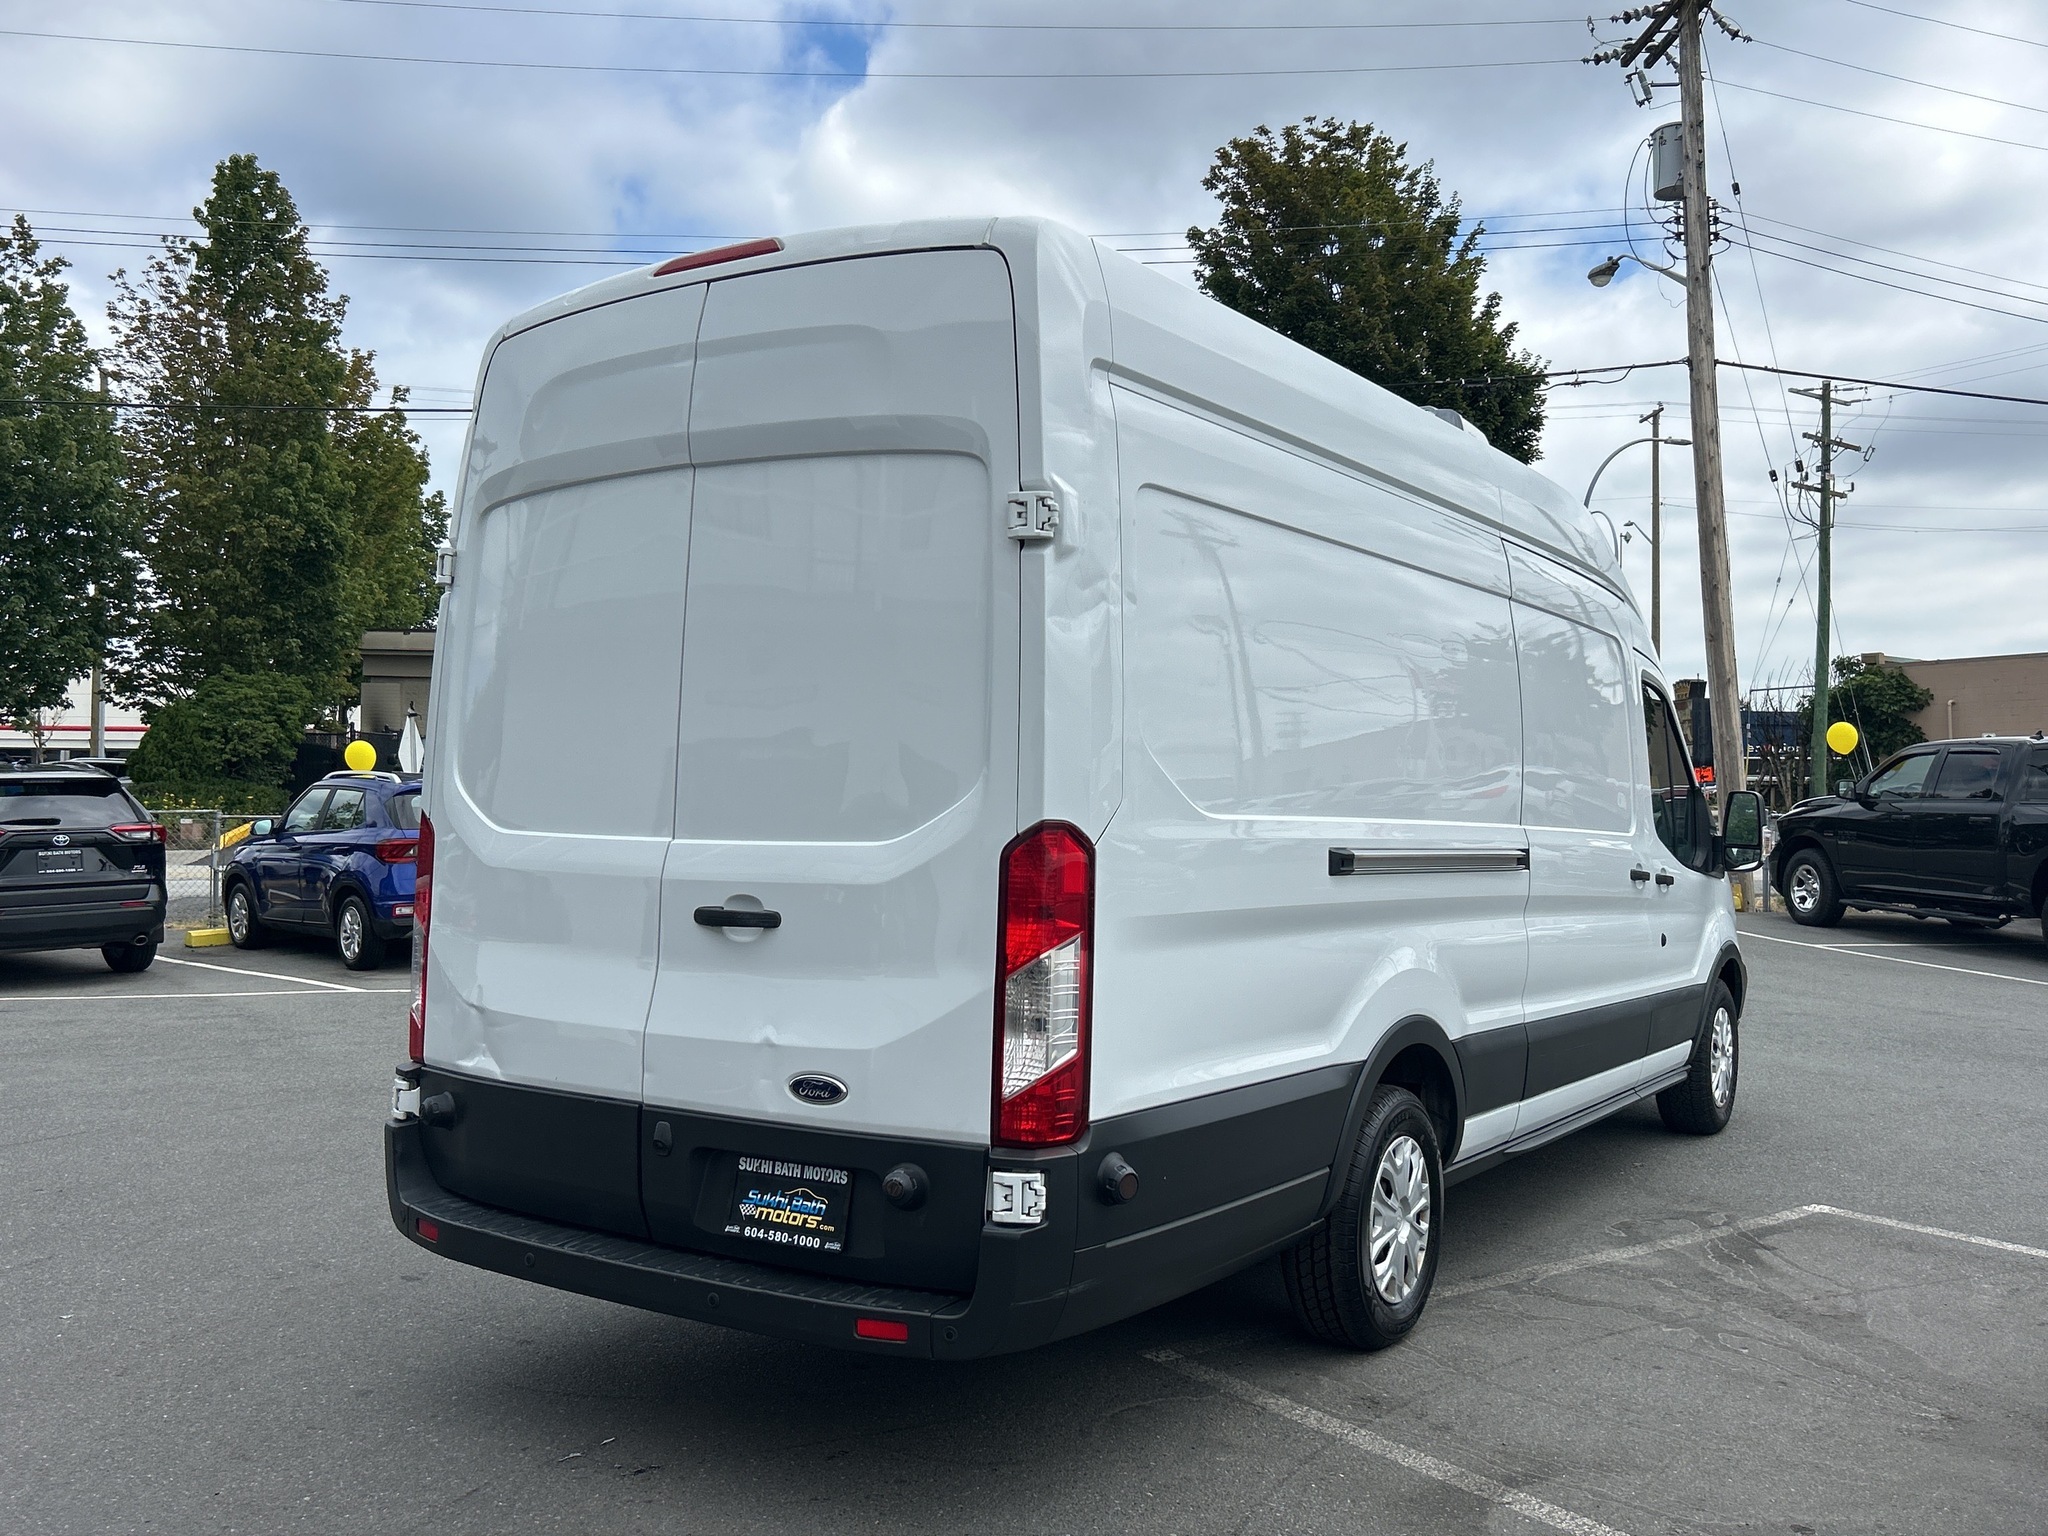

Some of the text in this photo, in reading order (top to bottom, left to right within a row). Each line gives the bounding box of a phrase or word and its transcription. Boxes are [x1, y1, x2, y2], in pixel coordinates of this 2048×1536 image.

[799, 1080, 831, 1098] Ford
[739, 1157, 848, 1184] SUKHI BATH MOTORS
[742, 1189, 827, 1216] Sukhi Bath
[744, 1226, 821, 1249] 604-580-1000
